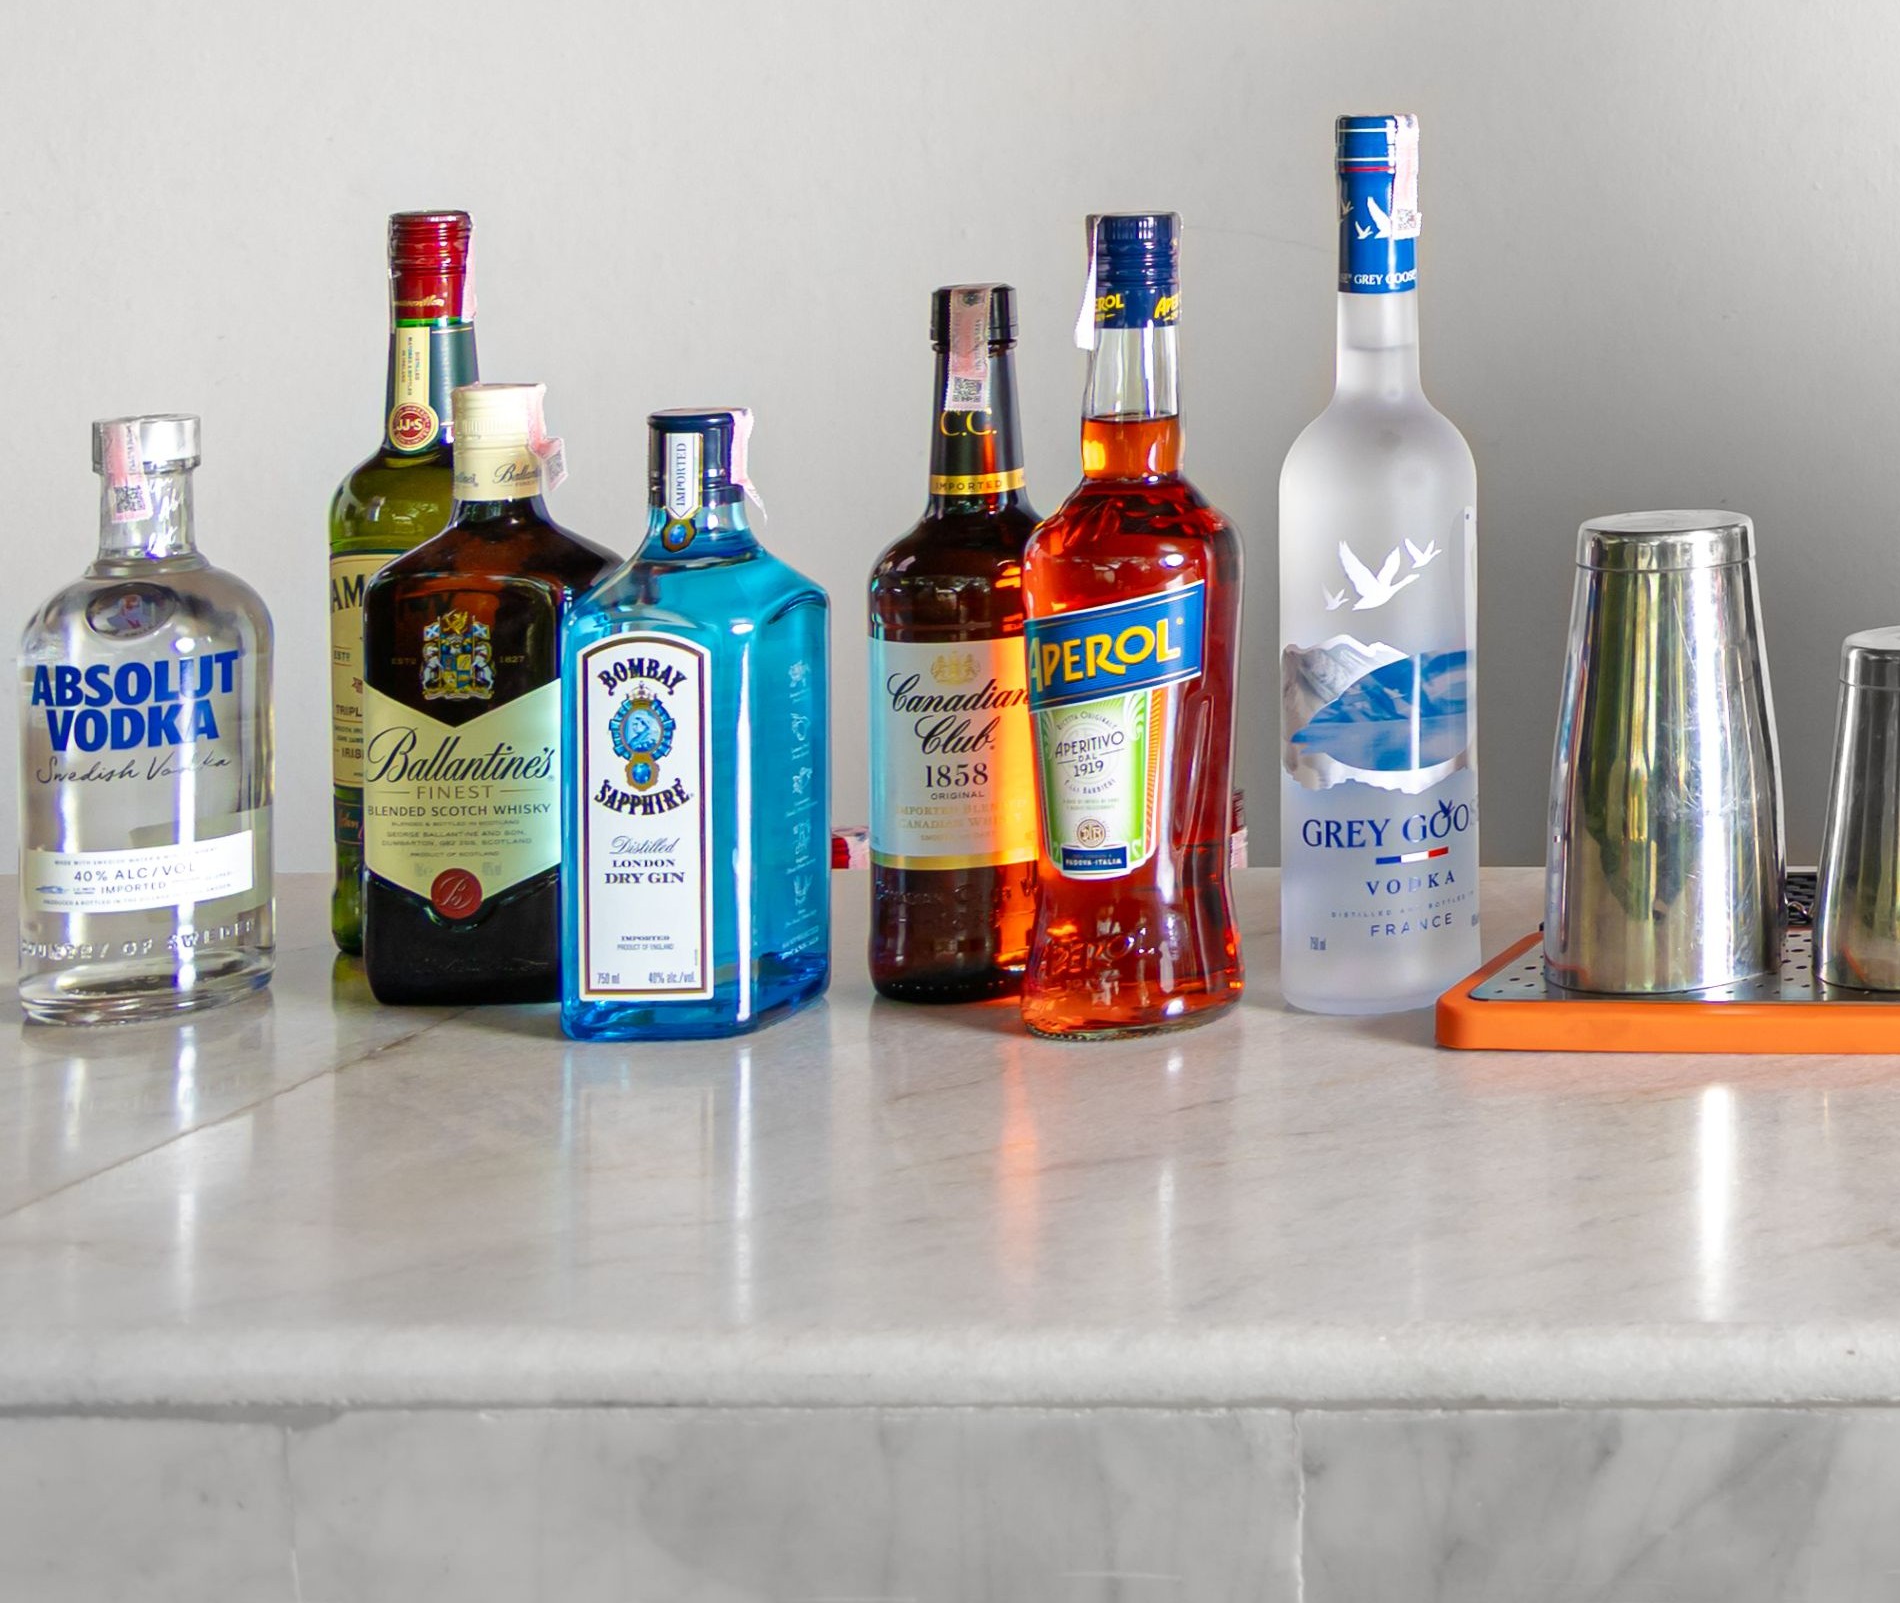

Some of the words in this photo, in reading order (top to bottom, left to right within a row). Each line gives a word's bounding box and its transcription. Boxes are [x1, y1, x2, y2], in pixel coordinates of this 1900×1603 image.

[1354, 273, 1383, 285] GREY
[676, 442, 687, 506] IMPORTED
[935, 480, 1003, 491] IMPORTED
[1029, 618, 1181, 693] APEROL
[31, 650, 239, 707] ABSOLUT
[598, 657, 687, 696] BOMBAY
[887, 672, 1030, 713] Canadian
[46, 700, 220, 752] VODKA
[341, 747, 364, 759] IRIS
[367, 726, 555, 783] Ballantine's
[1055, 731, 1125, 758] APERITIVO
[36, 755, 141, 784] Swedish
[1074, 760, 1104, 777] 1919
[1078, 754, 1097, 763] DAL
[925, 763, 988, 788] 1858
[417, 785, 494, 799] FINEST
[594, 778, 690, 815] SAPPHIRE
[931, 791, 984, 800] ORIGINAL
[368, 805, 426, 817] BLENDED
[432, 805, 487, 817] SCOTCH
[493, 803, 551, 815] WHISKY
[609, 835, 680, 855] Distilled
[1302, 818, 1391, 848] GREY
[74, 870, 108, 882] 40%
[115, 861, 195, 880] ALC/VOL
[612, 859, 676, 868] LONDON
[101, 881, 166, 895] IMPORTED
[605, 873, 644, 884] DRY
[648, 872, 685, 884] GIN
[1366, 869, 1455, 896] VODKA
[1370, 912, 1452, 937] FRANCE
